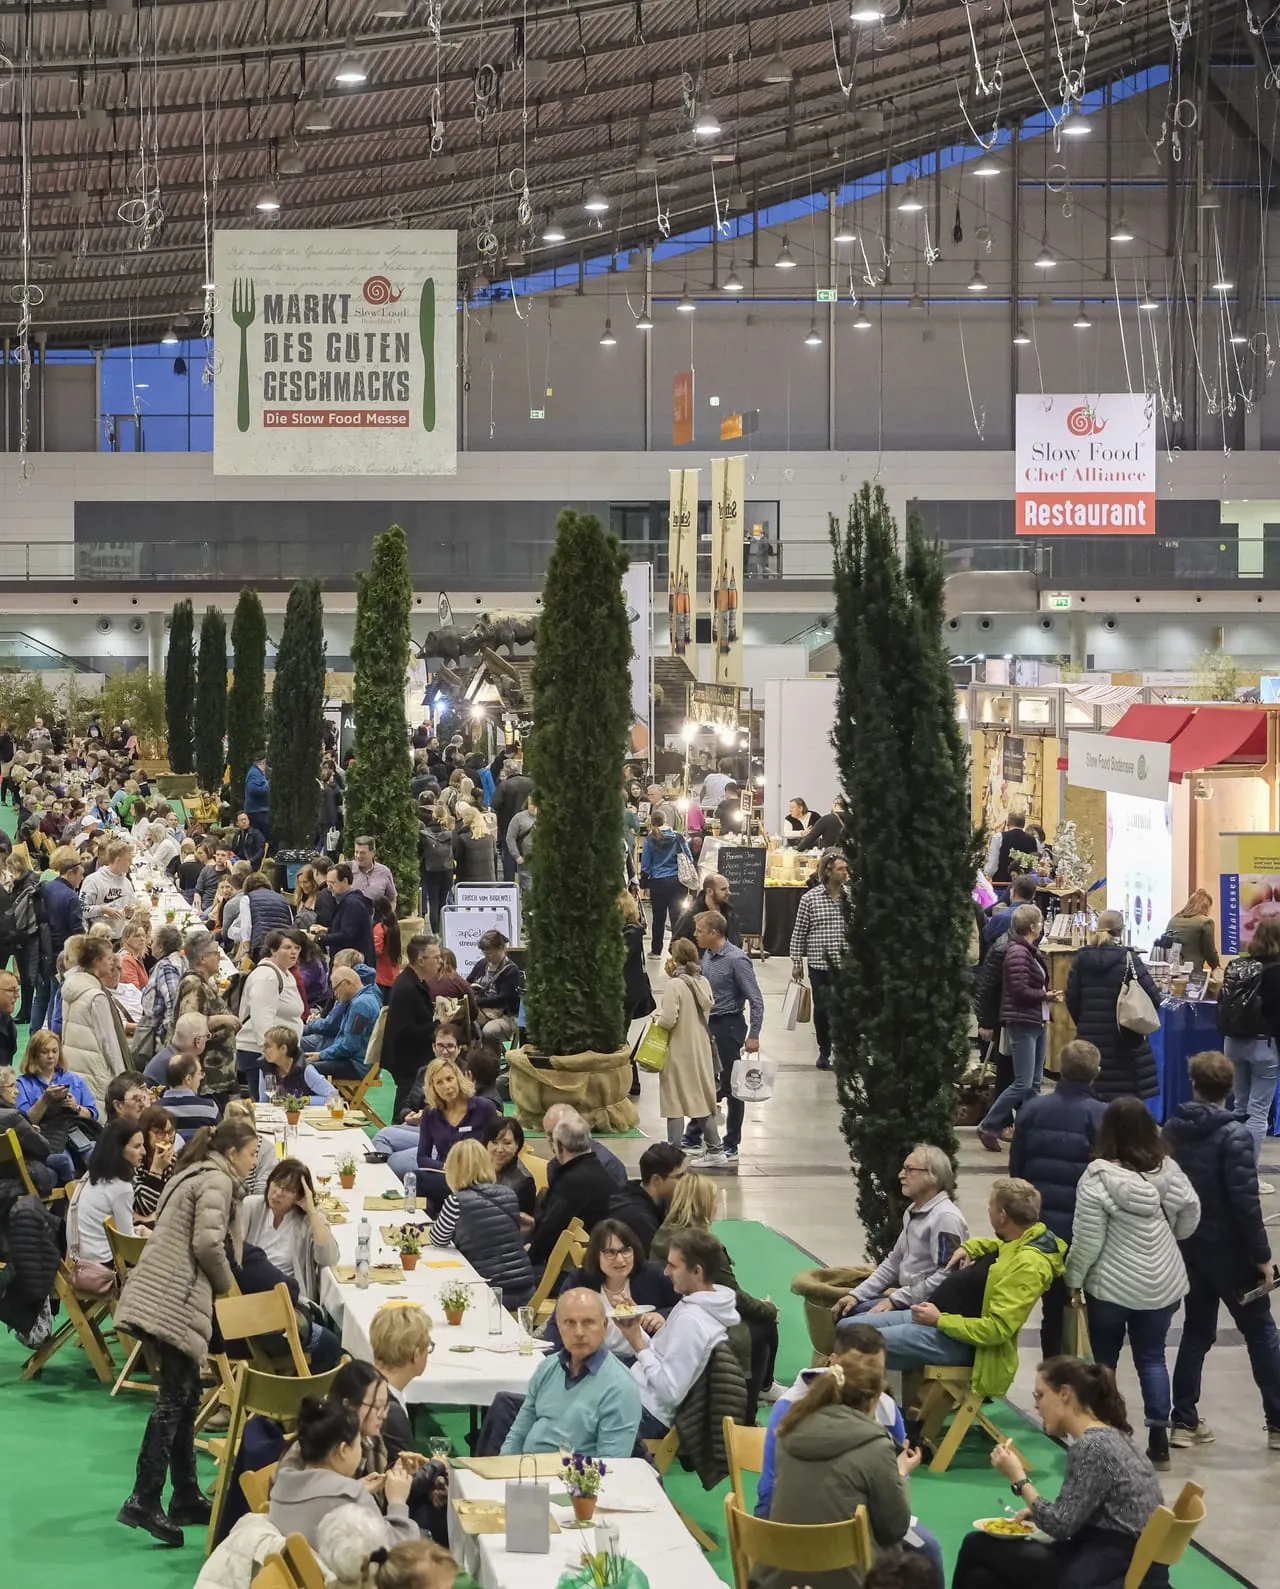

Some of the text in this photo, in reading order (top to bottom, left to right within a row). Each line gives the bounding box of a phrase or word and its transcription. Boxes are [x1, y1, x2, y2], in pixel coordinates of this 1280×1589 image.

[264, 294, 351, 324] MARKT
[264, 332, 410, 363] DES GUTEN
[264, 371, 410, 402] GESCHMACKS
[266, 413, 407, 425] Die Slow Food Messe
[1032, 442, 1080, 462] Slow
[1025, 467, 1147, 482] Chef Alliance
[1025, 500, 1146, 526] Restaurant
[1086, 752, 1135, 775] Slow Food Bodensee
[108, 888, 122, 896] NIKE
[1229, 876, 1237, 909] essen
